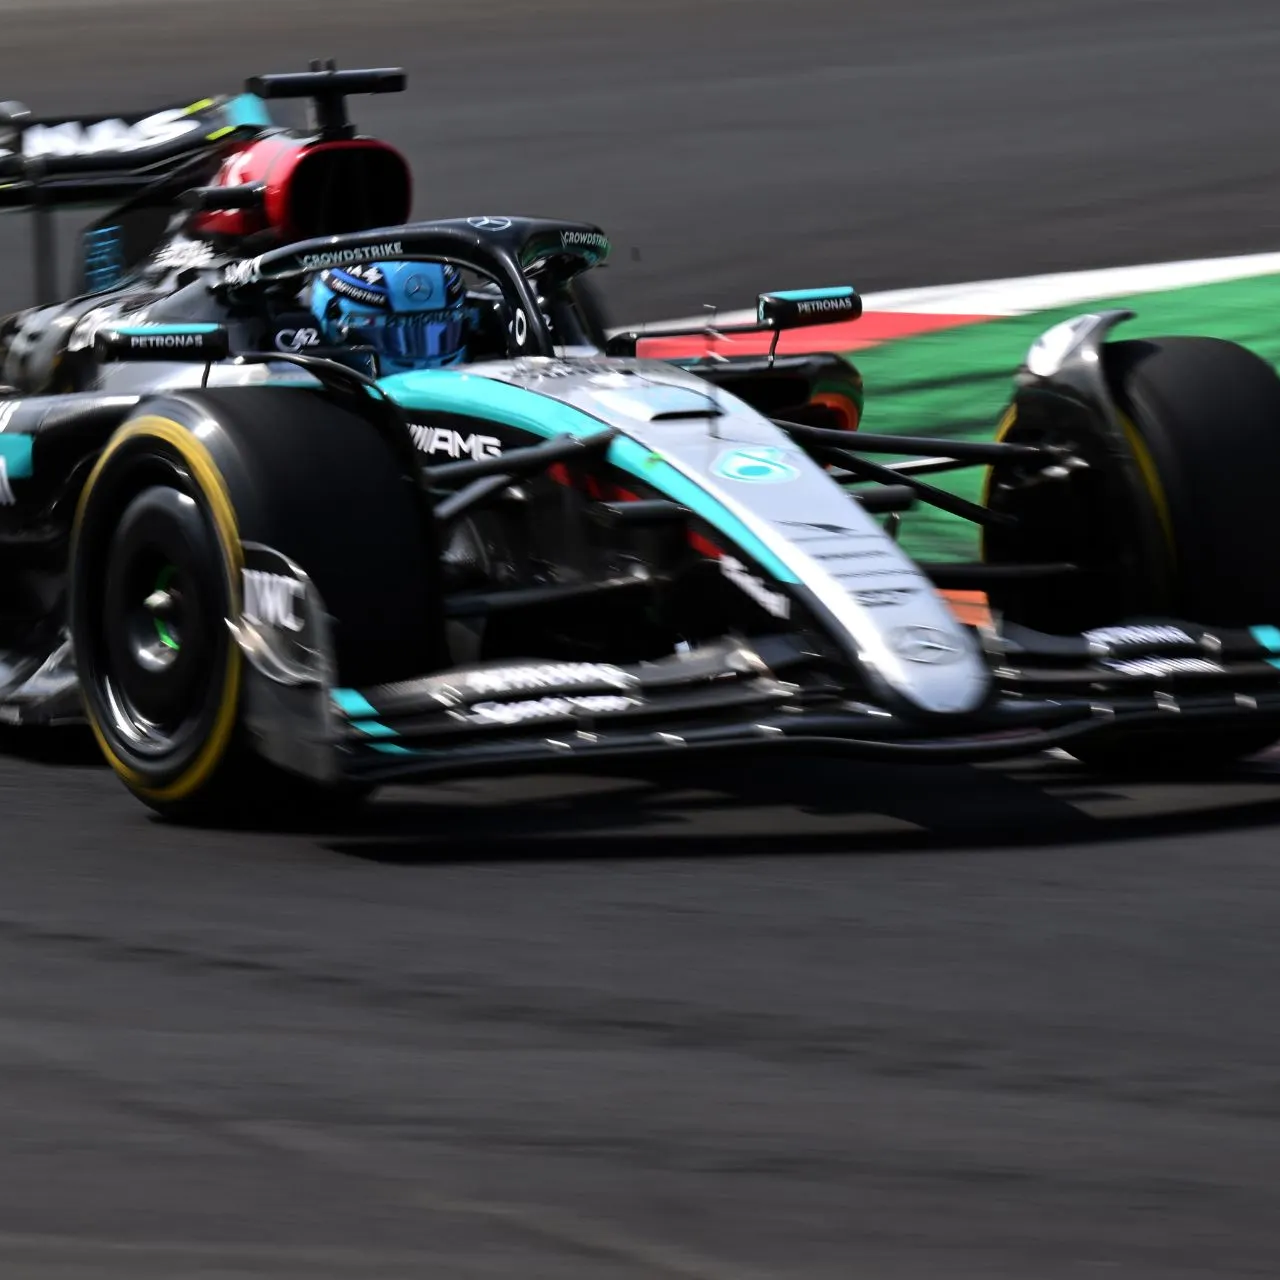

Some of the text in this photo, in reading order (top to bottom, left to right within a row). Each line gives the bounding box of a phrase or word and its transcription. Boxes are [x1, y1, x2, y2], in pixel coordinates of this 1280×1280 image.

[301, 241, 404, 269] CROWDSTRIKE
[797, 297, 853, 314] PETRONAS
[130, 334, 203, 348] PETRONAS
